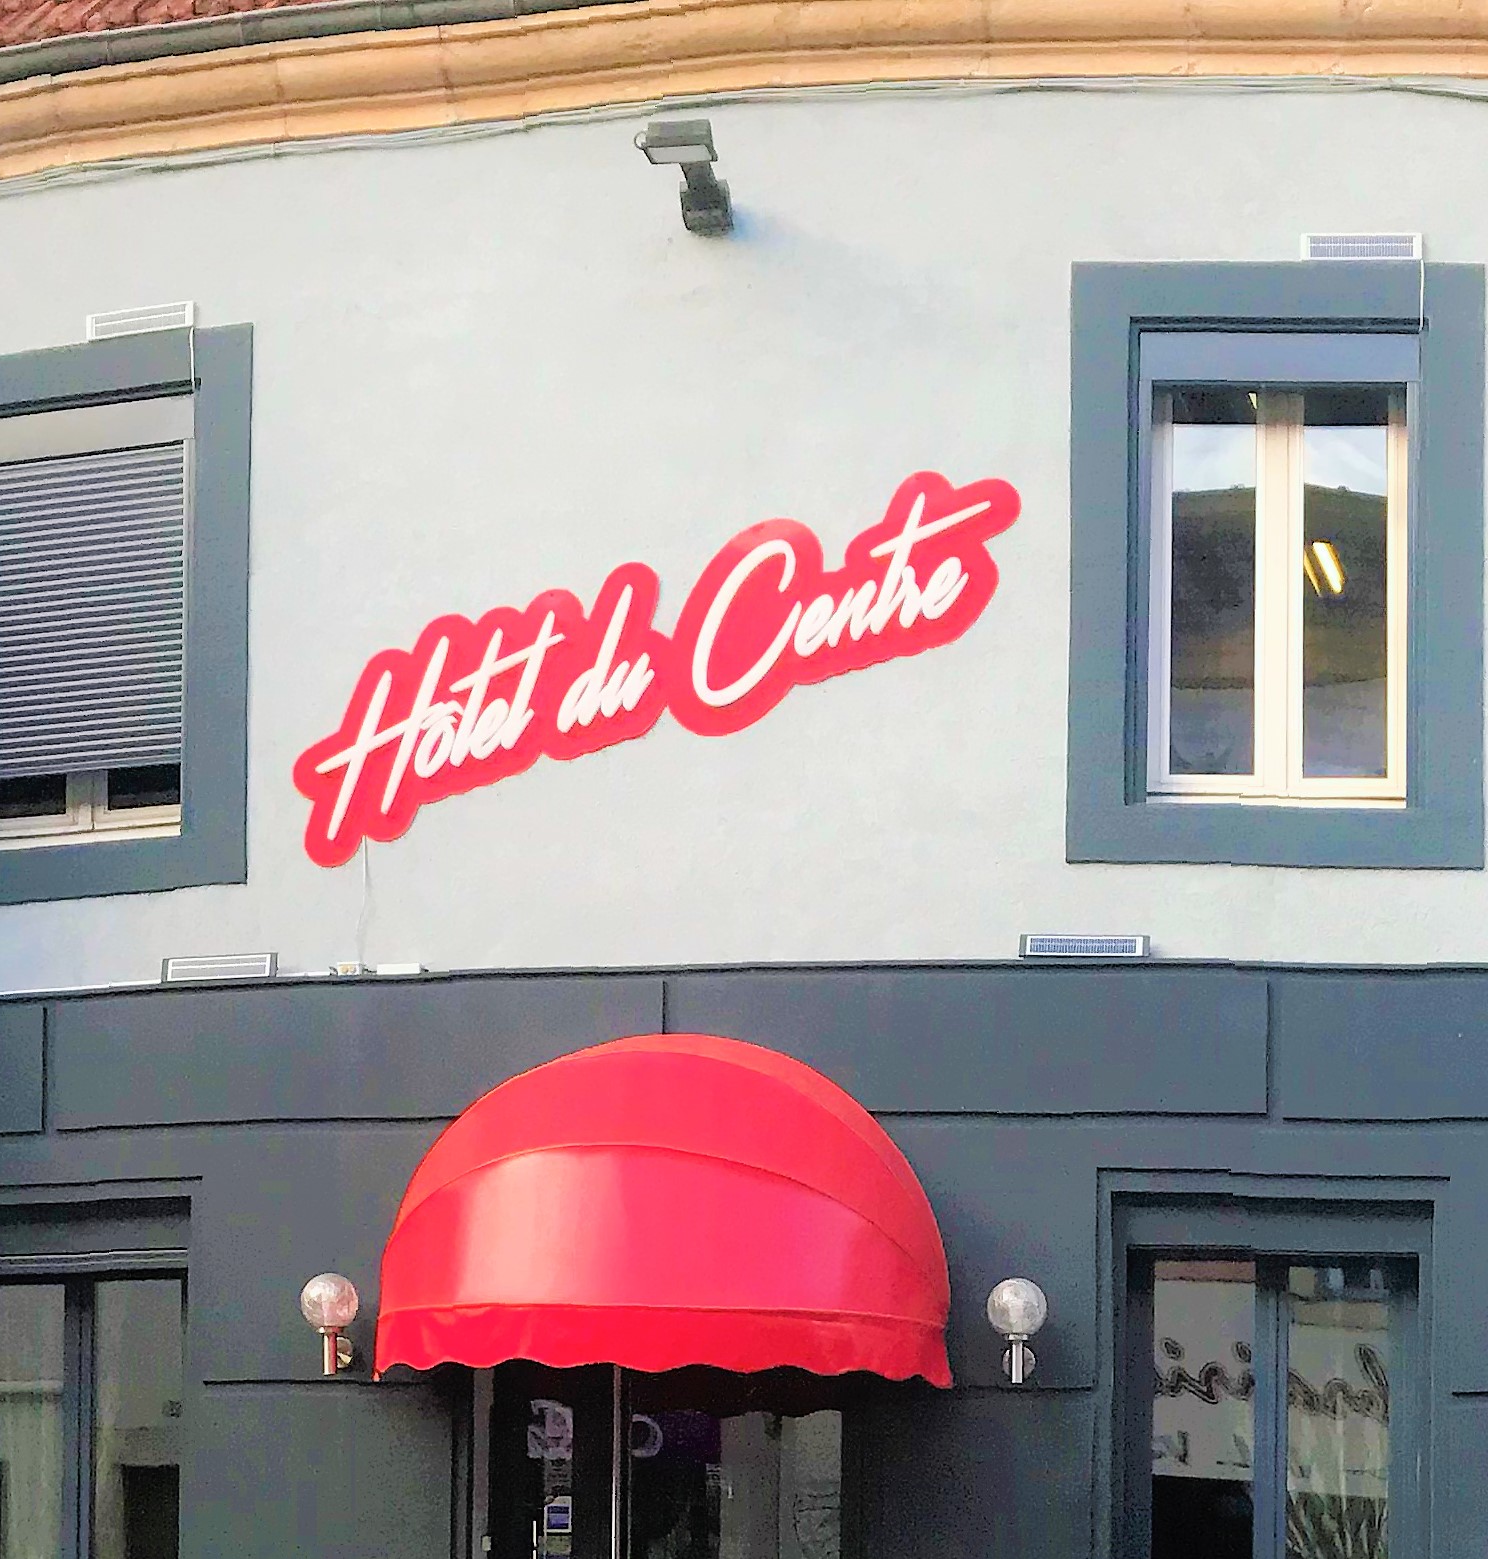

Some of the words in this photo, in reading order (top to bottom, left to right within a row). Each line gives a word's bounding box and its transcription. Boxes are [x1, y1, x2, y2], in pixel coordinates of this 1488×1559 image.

[315, 611, 565, 840] Hôtel
[556, 583, 655, 734] du
[692, 492, 992, 708] Centre
